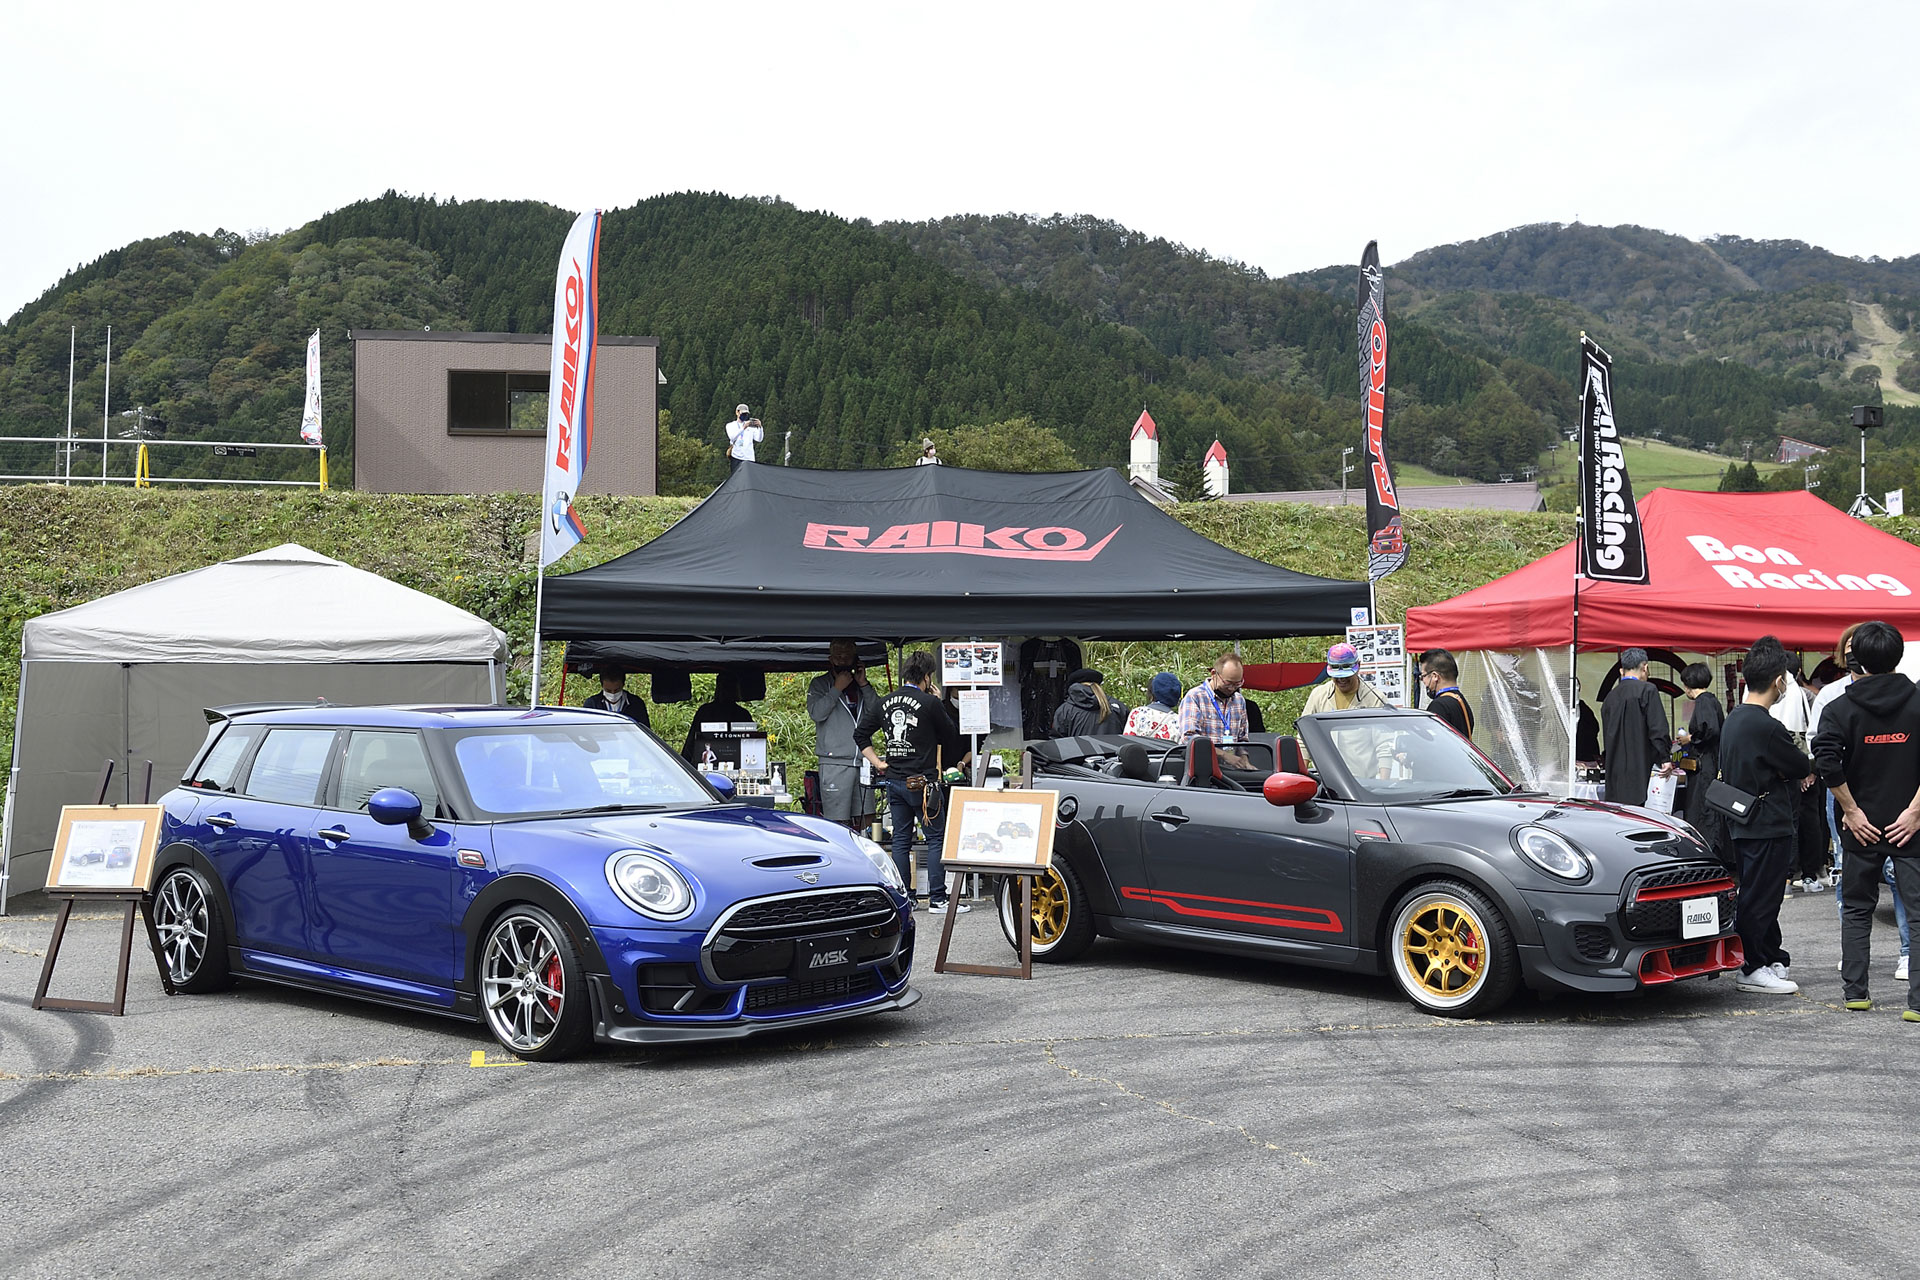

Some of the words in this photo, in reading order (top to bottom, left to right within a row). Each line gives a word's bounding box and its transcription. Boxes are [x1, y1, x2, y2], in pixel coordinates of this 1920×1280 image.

[556, 262, 583, 472] RAIKO
[1596, 441, 1633, 570] Racing
[803, 520, 1096, 557] RAIKO
[1686, 535, 1803, 566] Bon
[1711, 564, 1912, 597] Racing
[1864, 732, 1909, 744] RAIKO
[1686, 911, 1713, 925] RAIKO
[810, 948, 849, 968] MSK
